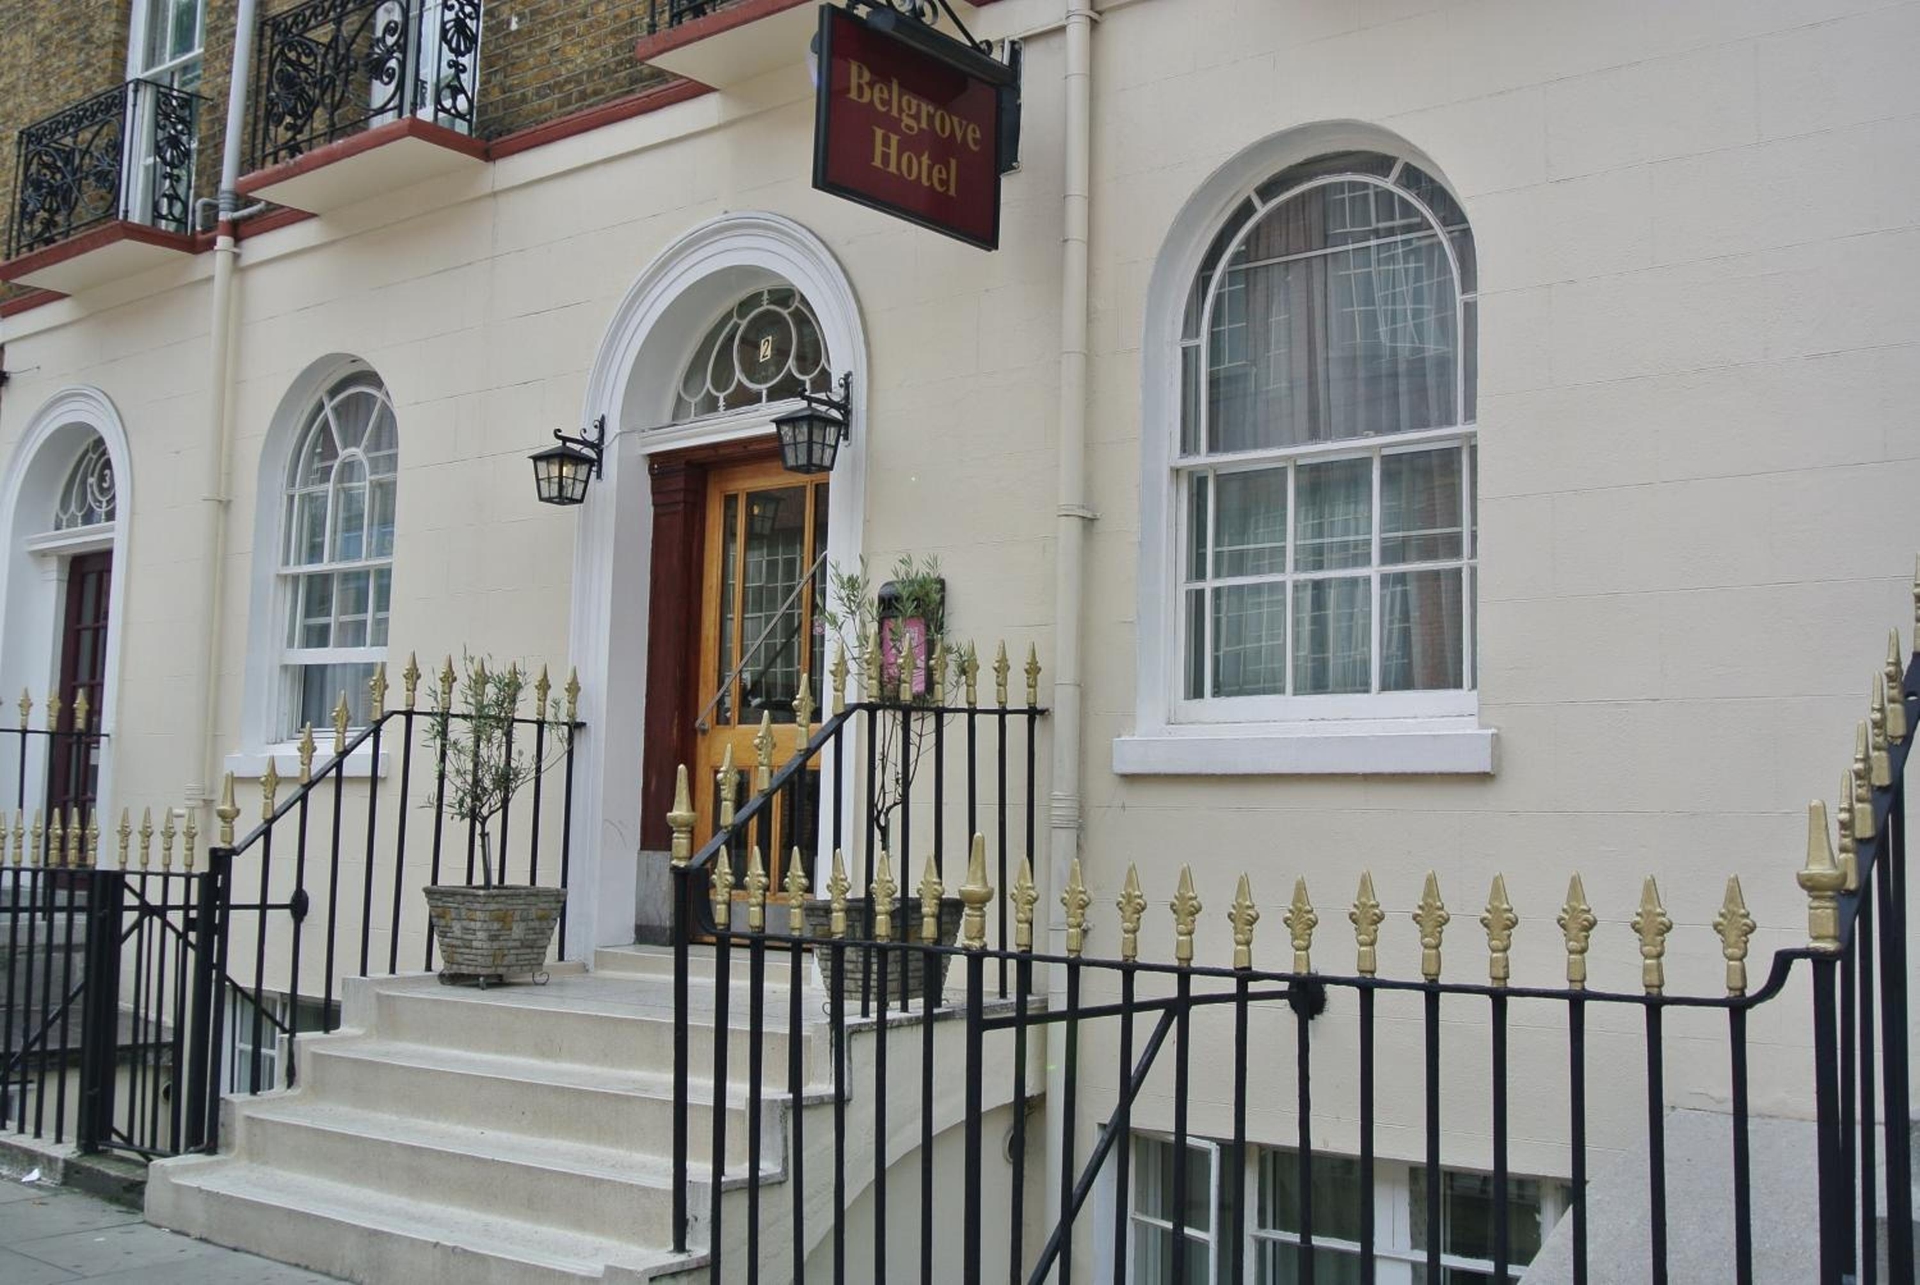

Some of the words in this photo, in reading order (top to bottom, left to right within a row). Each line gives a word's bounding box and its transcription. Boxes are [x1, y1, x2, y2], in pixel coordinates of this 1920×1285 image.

[847, 59, 982, 151] Belgrove
[871, 125, 957, 198] Hotel
[762, 338, 771, 359] 2
[102, 469, 111, 488] 3
